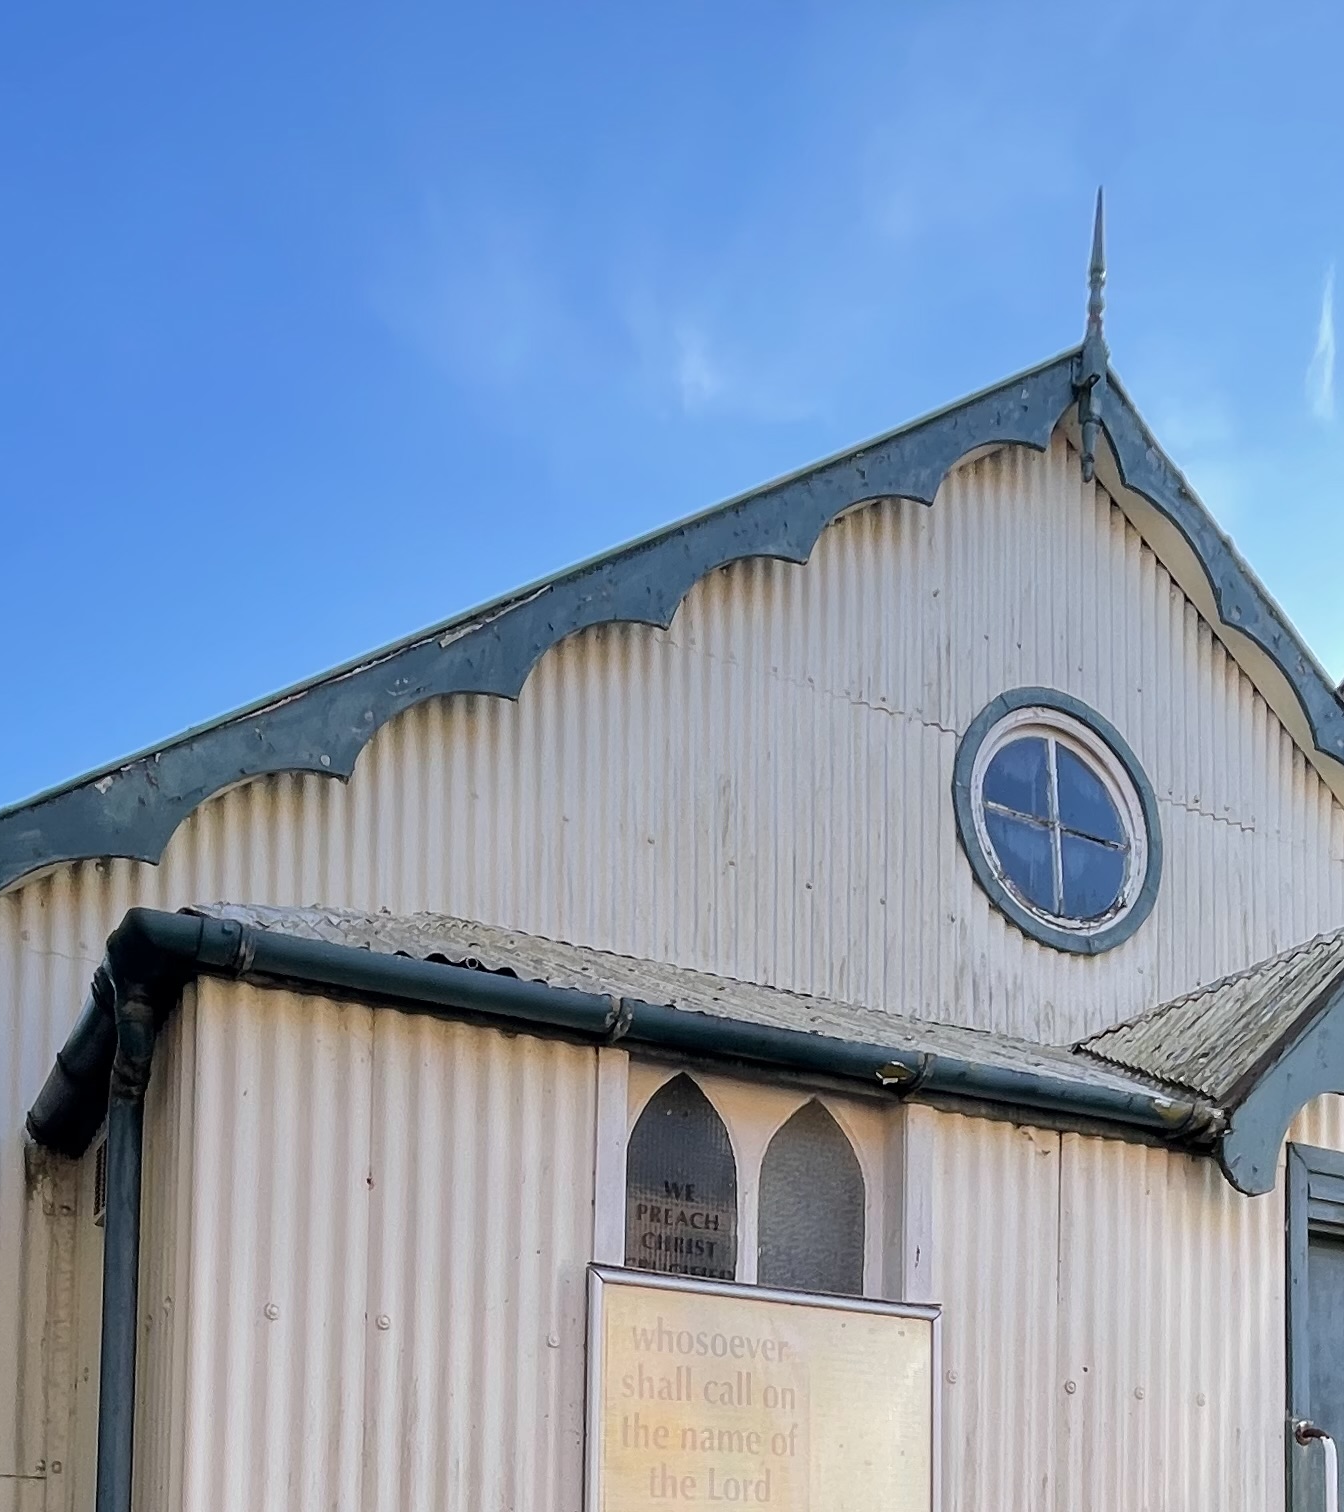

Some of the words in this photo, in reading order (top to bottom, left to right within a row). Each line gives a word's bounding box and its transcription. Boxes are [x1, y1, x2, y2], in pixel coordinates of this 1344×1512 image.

[664, 1180, 696, 1203] WE
[637, 1203, 719, 1231] PREACH
[641, 1231, 717, 1258] CHRIST
[632, 1316, 789, 1363] whosoever
[621, 1363, 692, 1402] shall
[703, 1370, 752, 1407] call
[762, 1383, 796, 1410] on
[621, 1412, 670, 1450] the
[680, 1424, 761, 1455] name
[772, 1422, 798, 1457] of
[649, 1462, 697, 1501] the
[708, 1467, 771, 1503] Lord
